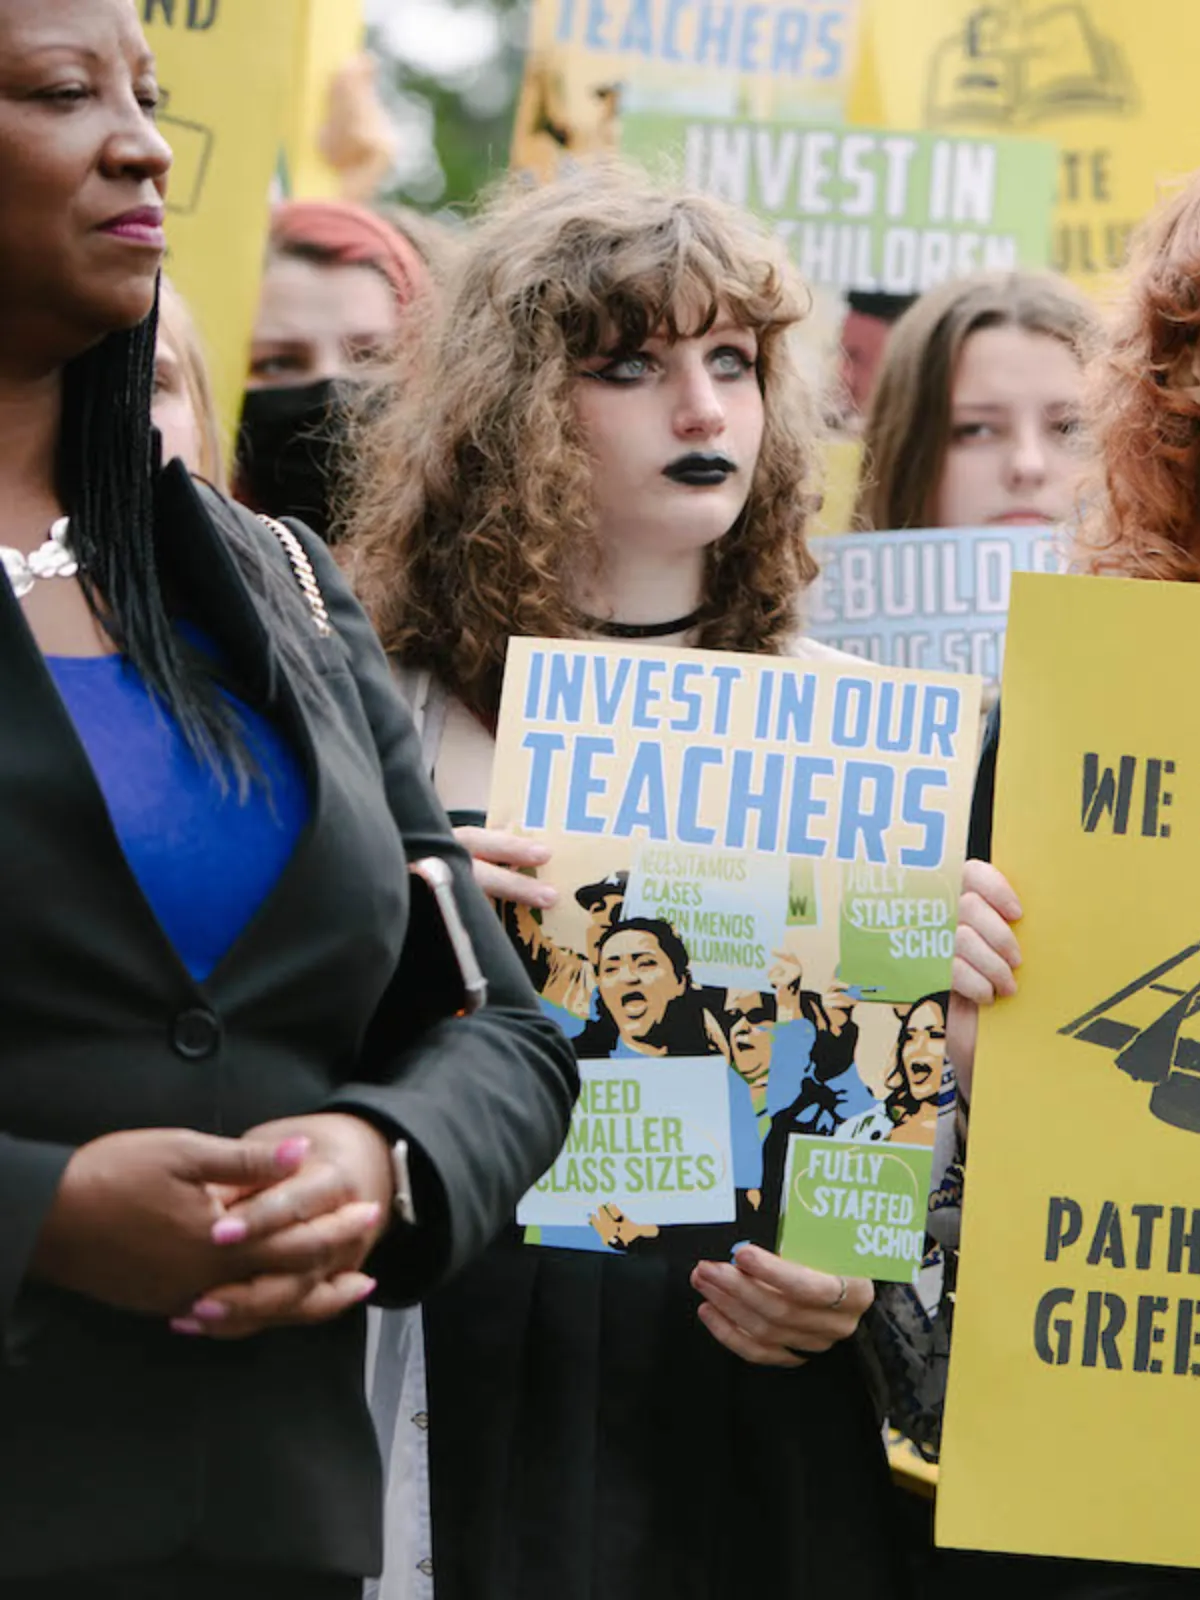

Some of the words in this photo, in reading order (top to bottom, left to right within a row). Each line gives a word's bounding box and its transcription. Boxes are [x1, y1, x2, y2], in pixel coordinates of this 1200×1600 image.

[685, 123, 917, 219] INVEST
[929, 139, 997, 224] IN
[811, 538, 1011, 623] EBUILD
[524, 651, 743, 736] INVEST
[754, 669, 817, 744] IN
[831, 677, 962, 758] OUR
[521, 732, 949, 869] TEACHERS
[1080, 752, 1176, 838] WE
[642, 877, 703, 907] CLASES
[694, 909, 755, 940] MENOS
[850, 897, 948, 929] STAFFED
[684, 937, 766, 969] ALUMNOS
[624, 1154, 716, 1193] SIZES
[808, 1149, 885, 1186] FULLY
[812, 1185, 914, 1226] STAFFED
